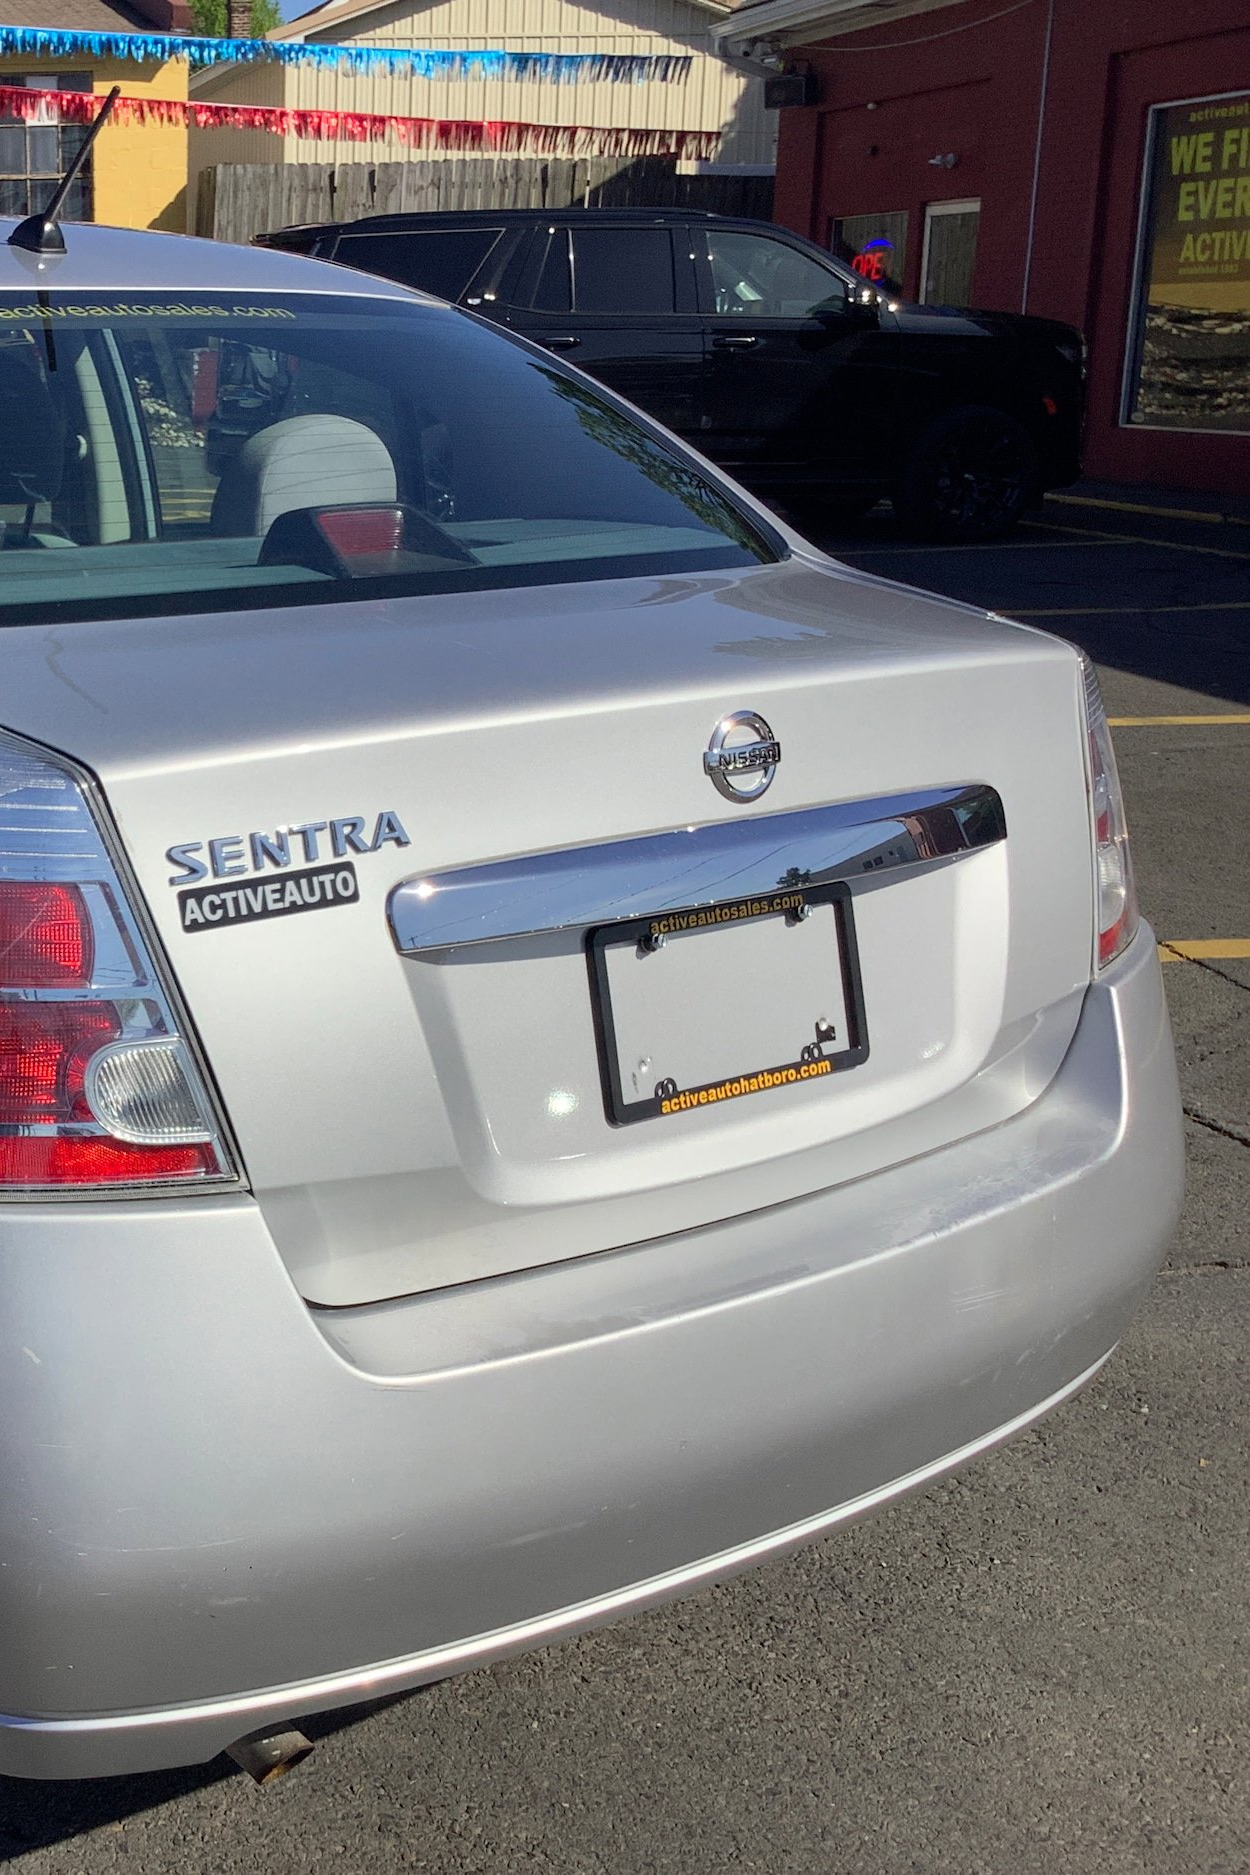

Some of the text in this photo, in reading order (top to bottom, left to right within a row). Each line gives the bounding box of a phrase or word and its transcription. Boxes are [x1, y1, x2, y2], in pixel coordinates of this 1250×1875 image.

[1171, 132, 1214, 175] WE
[852, 252, 888, 280] OPE
[718, 744, 778, 769] NISSAN
[165, 810, 411, 886] SENTRA
[184, 870, 355, 926] ACTIVEAUTO
[650, 894, 804, 935] activeautosales.com
[661, 1059, 831, 1114] activeautohatboro.com
